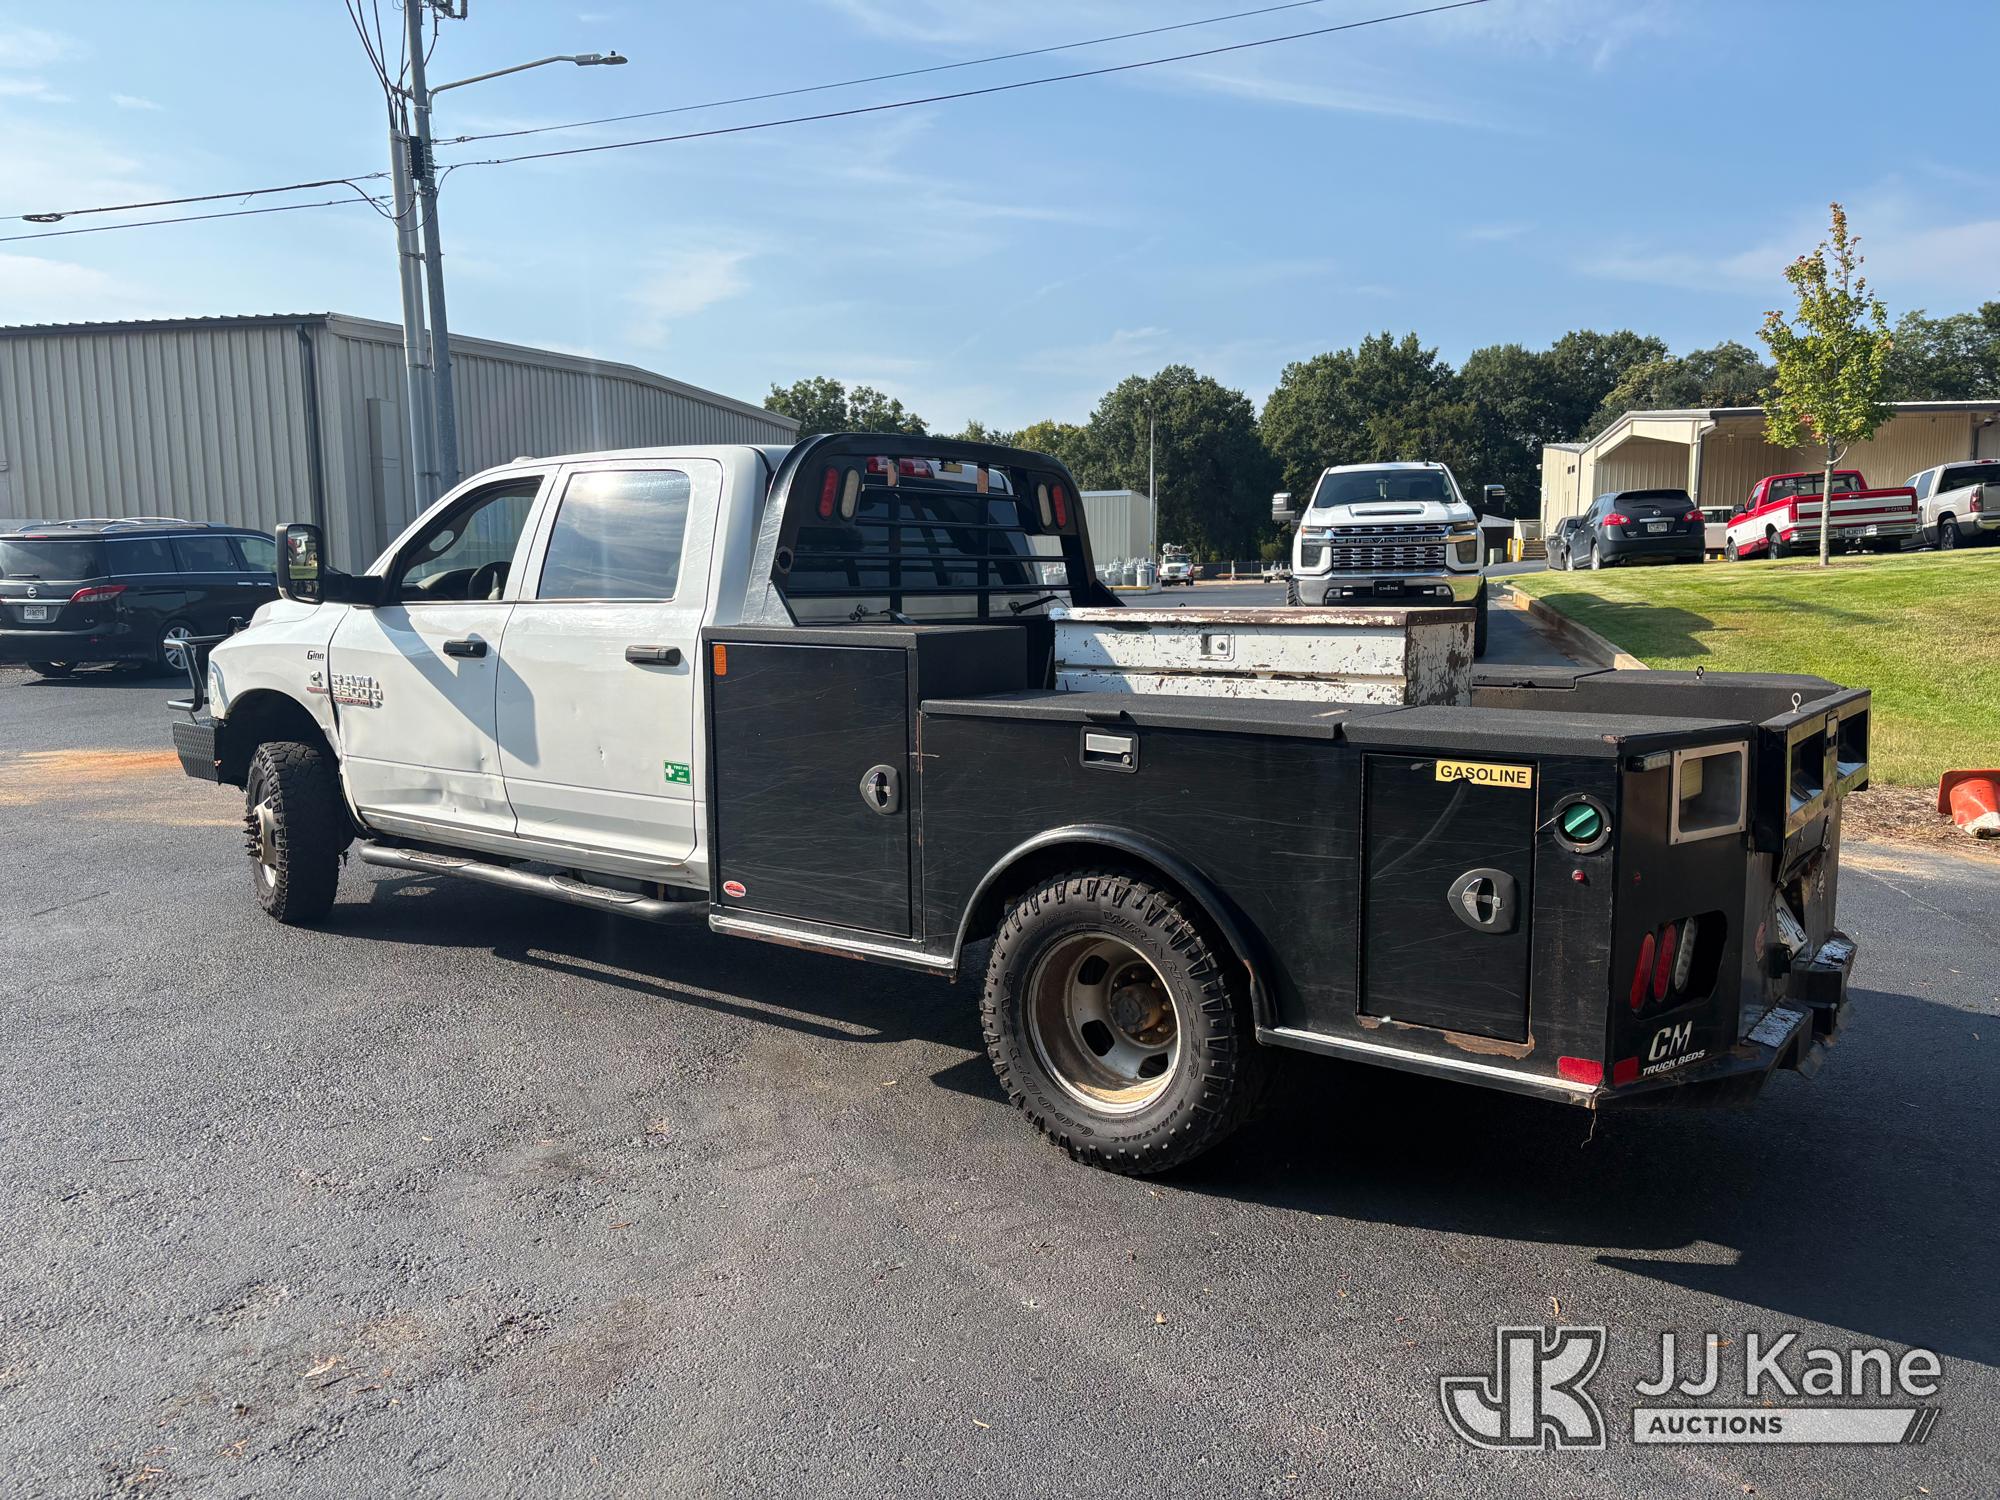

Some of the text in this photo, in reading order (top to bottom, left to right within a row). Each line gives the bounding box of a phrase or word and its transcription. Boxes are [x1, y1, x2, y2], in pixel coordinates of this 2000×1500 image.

[307, 650, 325, 660] Ginn
[1440, 765, 1527, 784] GASOLINE
[1648, 1020, 1693, 1061] CM
[1642, 1049, 1706, 1077] TRUCK BEDS
